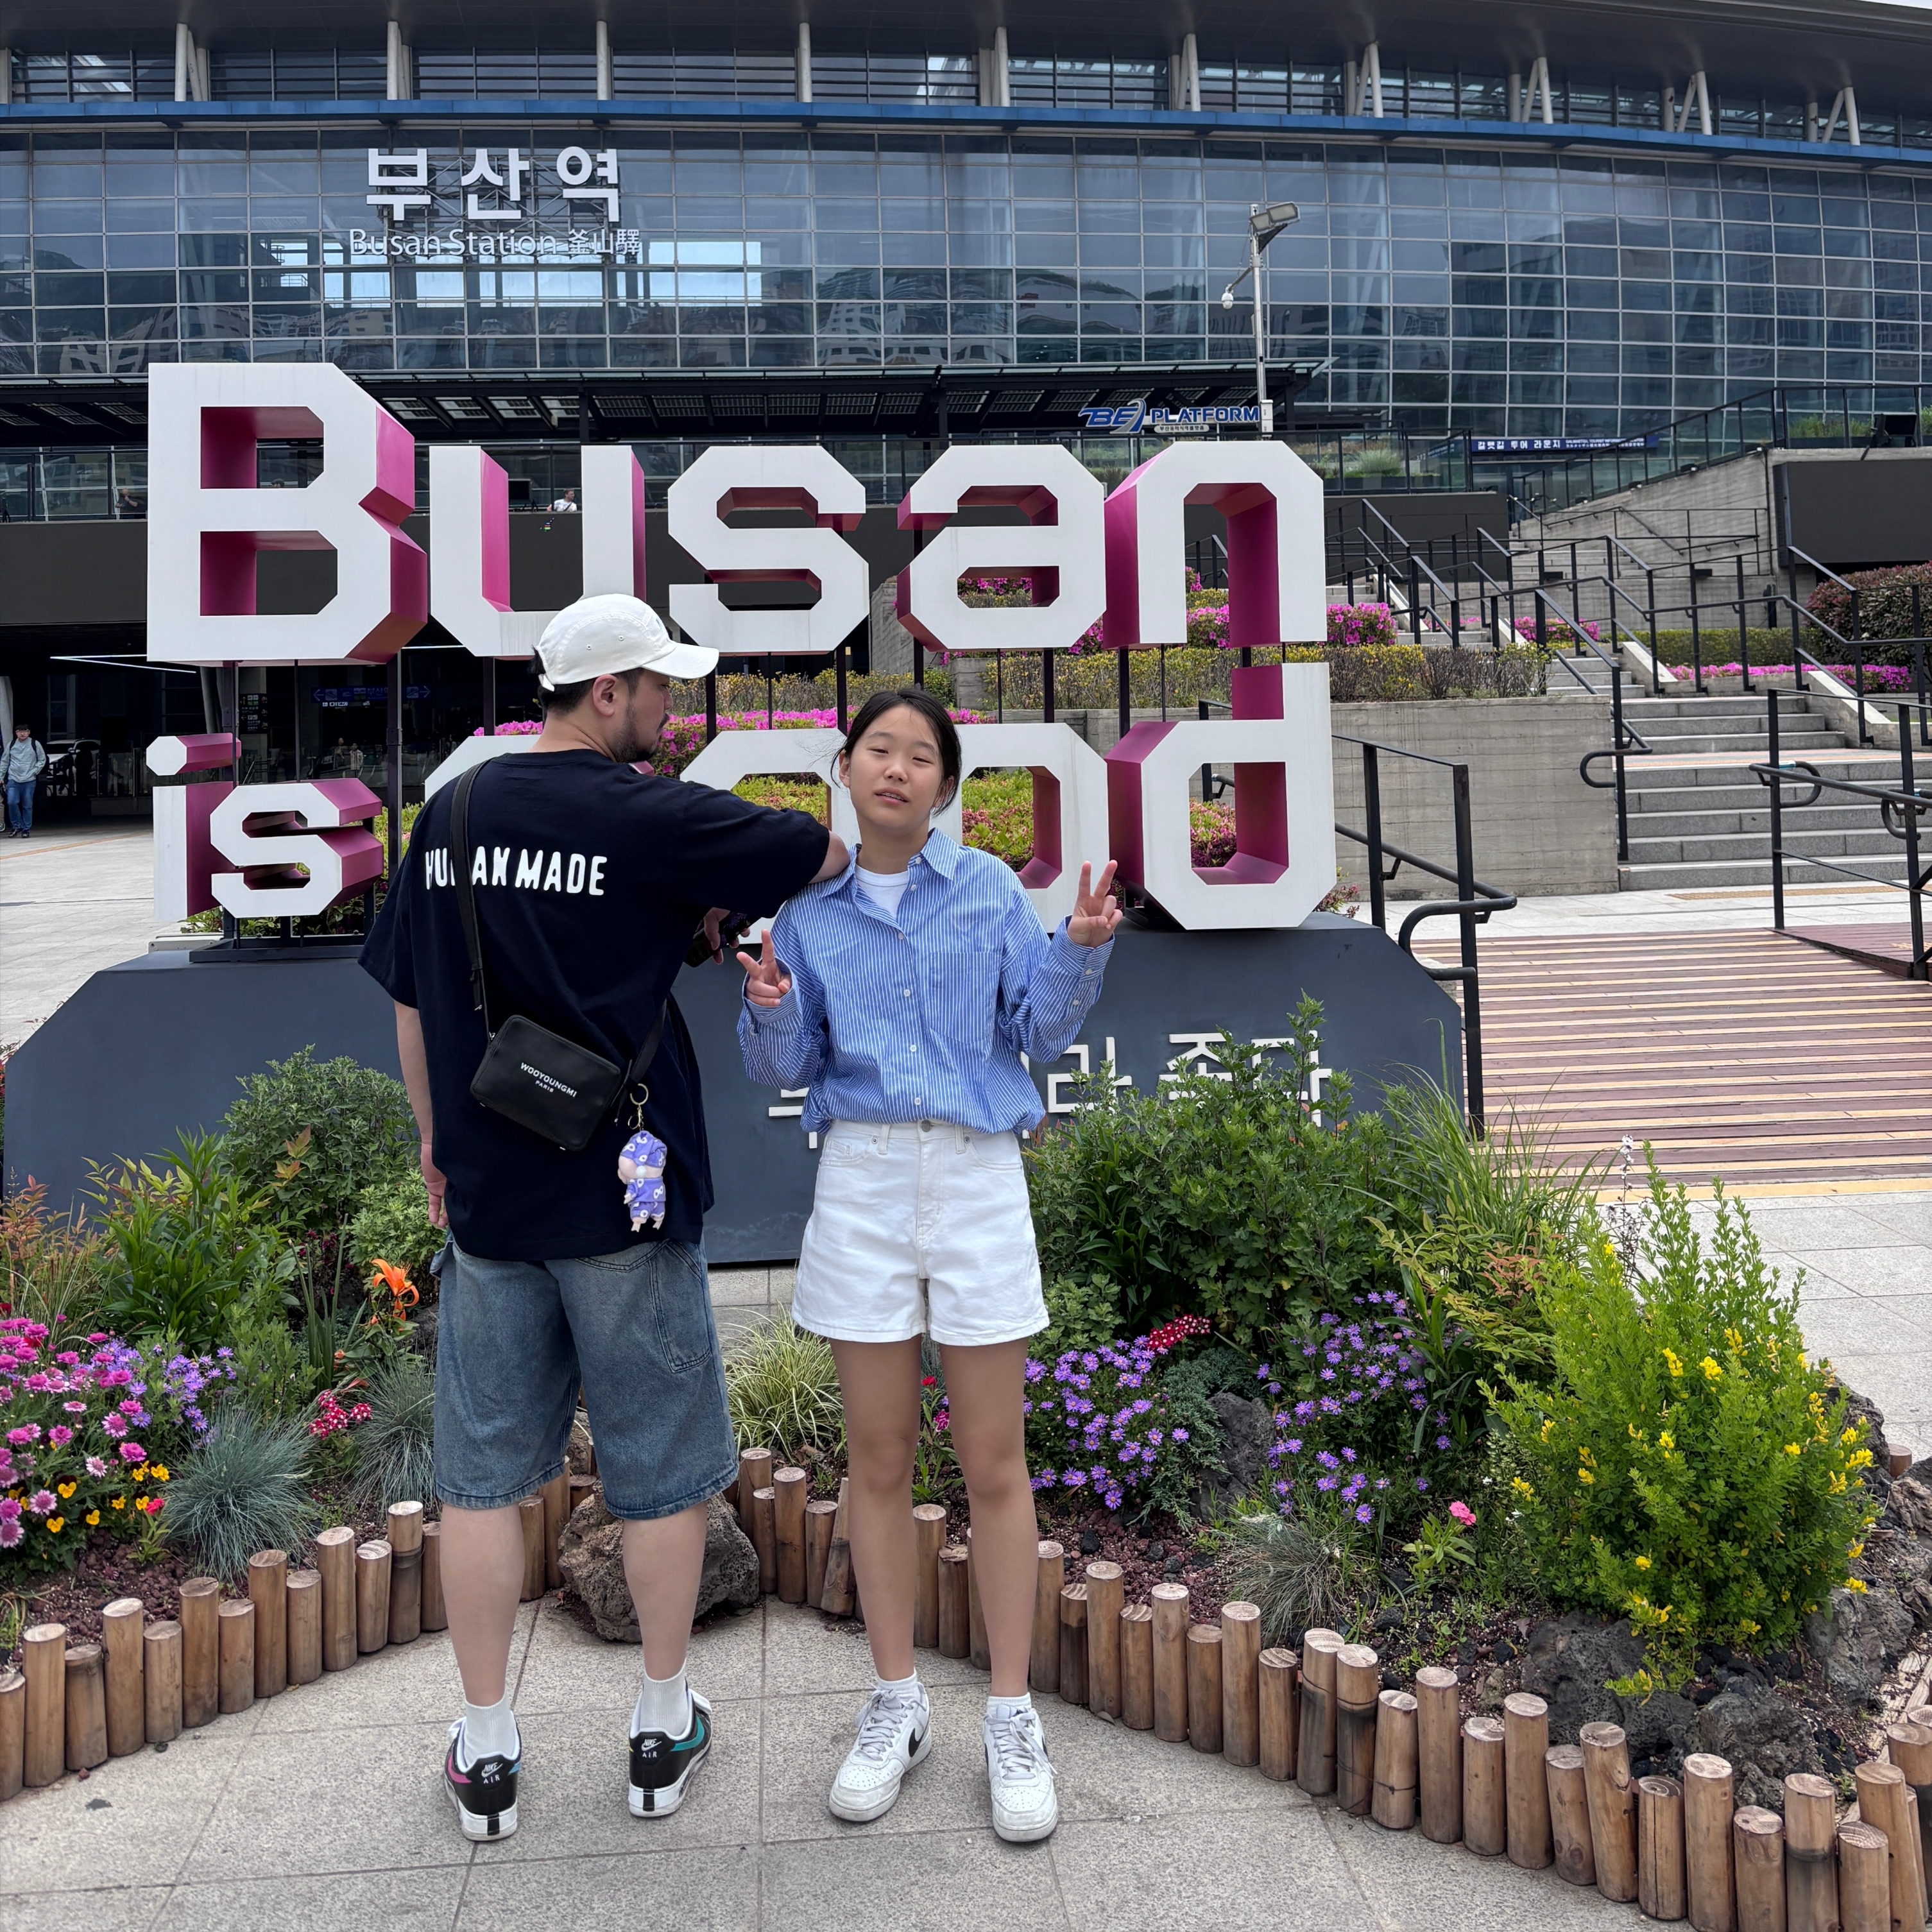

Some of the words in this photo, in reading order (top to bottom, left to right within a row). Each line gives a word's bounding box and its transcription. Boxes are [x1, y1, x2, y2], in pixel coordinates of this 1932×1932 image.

[366, 146, 620, 222] 부산역
[350, 228, 441, 255] Busan
[449, 228, 557, 255] Station
[568, 228, 640, 255] 釜山驛
[1150, 406, 1260, 424] PLATFORM
[1510, 440, 1528, 450] 투어
[1534, 440, 1560, 449] 라운지
[147, 362, 1328, 664] Busan
[146, 733, 384, 921] is
[515, 848, 608, 896] MADE
[520, 1062, 577, 1098] WOOYOUNGMI
[535, 1080, 554, 1093] PARIS
[644, 1738, 657, 1747] NIKE
[483, 1774, 500, 1784] AIR
[484, 1761, 498, 1773] NIKE
